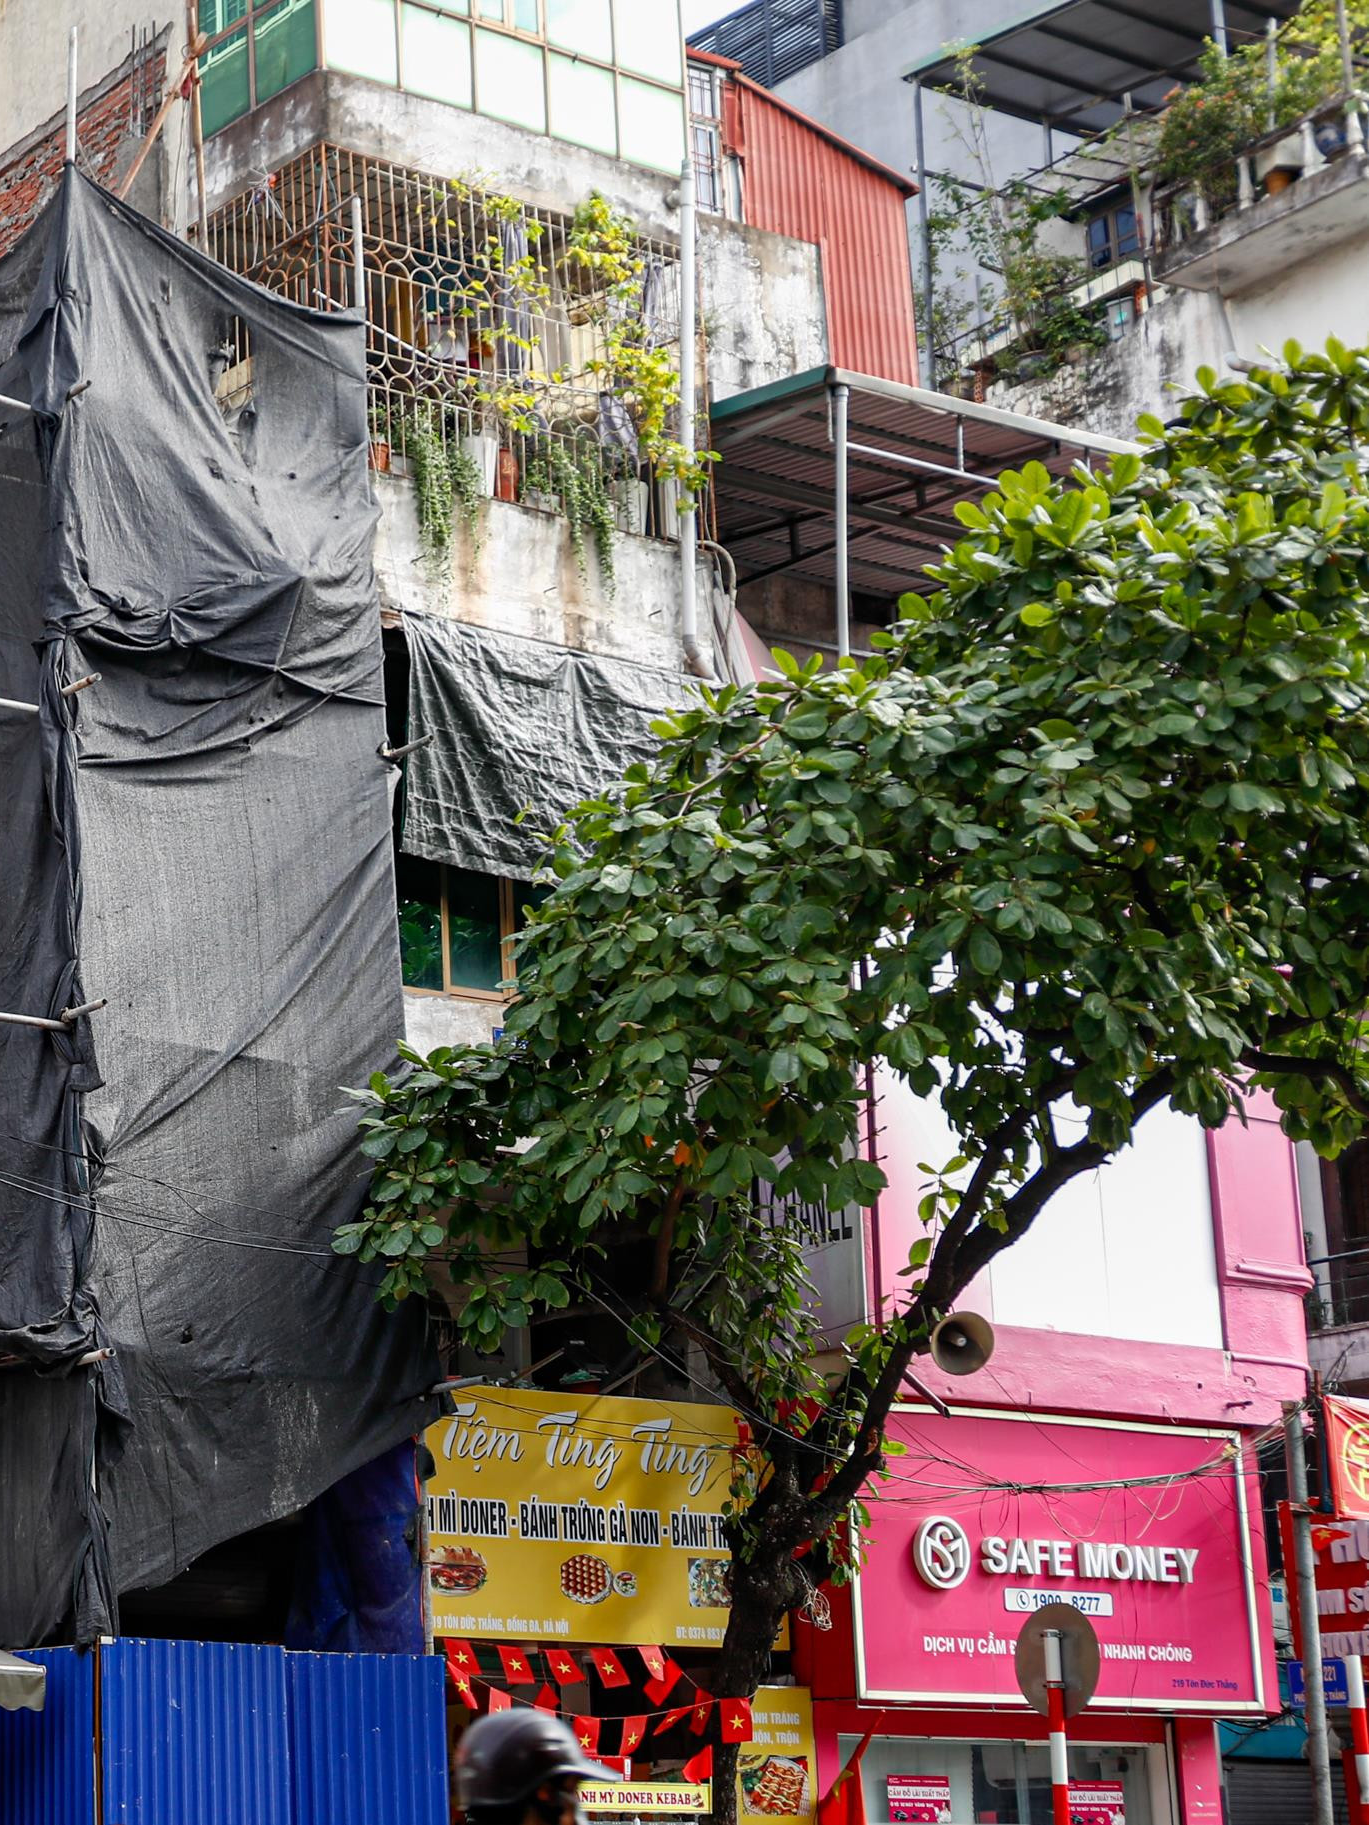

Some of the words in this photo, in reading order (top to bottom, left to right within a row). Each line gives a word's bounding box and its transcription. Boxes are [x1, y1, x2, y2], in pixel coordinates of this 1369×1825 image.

[442, 1402, 525, 1473] Tiệm
[536, 1410, 622, 1490] Ting
[631, 1418, 716, 1497] Ting
[438, 1490, 457, 1529] MÌ
[460, 1498, 508, 1536] DONER
[519, 1494, 558, 1539] BÁNH
[561, 1499, 607, 1544] TRỨNG
[609, 1501, 629, 1544] GÀ
[630, 1510, 660, 1547] NON
[671, 1504, 708, 1549] BÁNH
[981, 1535, 1075, 1577] SAFE
[1078, 1540, 1199, 1583] MONEY
[923, 1635, 955, 1656] DỊCH
[958, 1637, 974, 1657] VỤ
[977, 1631, 1007, 1655] CẦM
[1104, 1647, 1146, 1661] NHANH
[1149, 1644, 1192, 1662] CHÓNG
[618, 1791, 654, 1805] DONER
[656, 1792, 692, 1806] KEBAB
